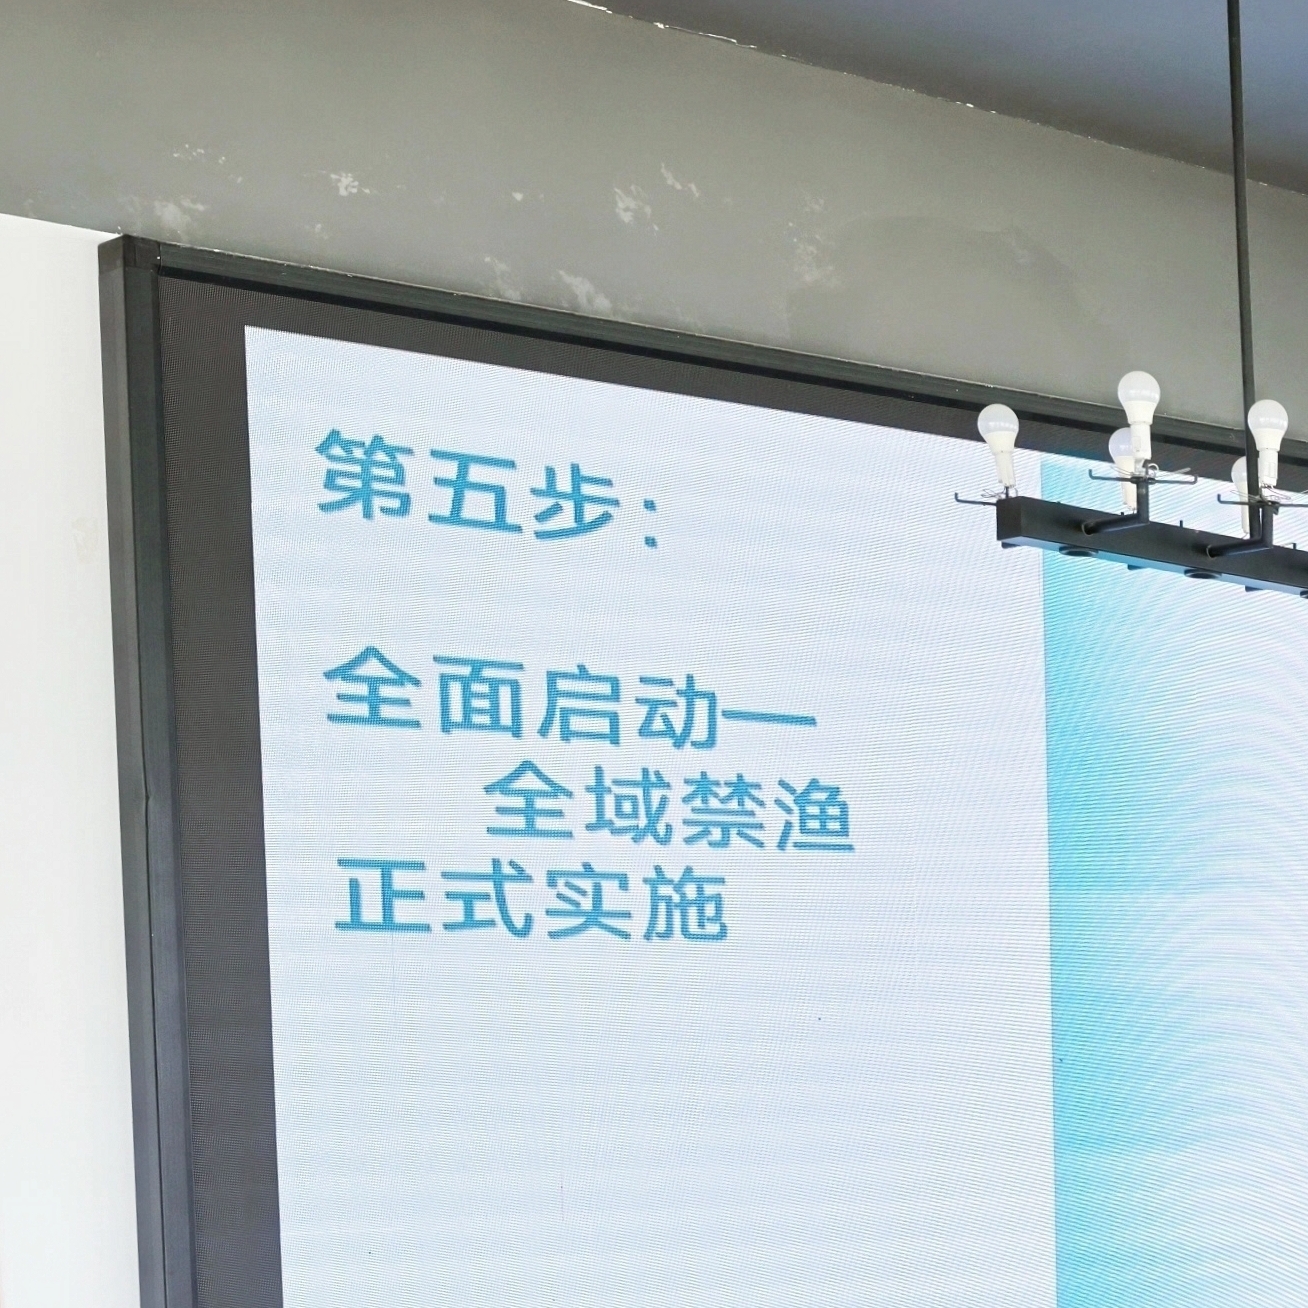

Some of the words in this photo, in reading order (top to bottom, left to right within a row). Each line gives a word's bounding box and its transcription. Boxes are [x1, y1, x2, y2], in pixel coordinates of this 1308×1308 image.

[315, 428, 657, 549] 第五步：
[483, 760, 854, 852] 全域禁渔
[335, 858, 728, 942] 正式实施
